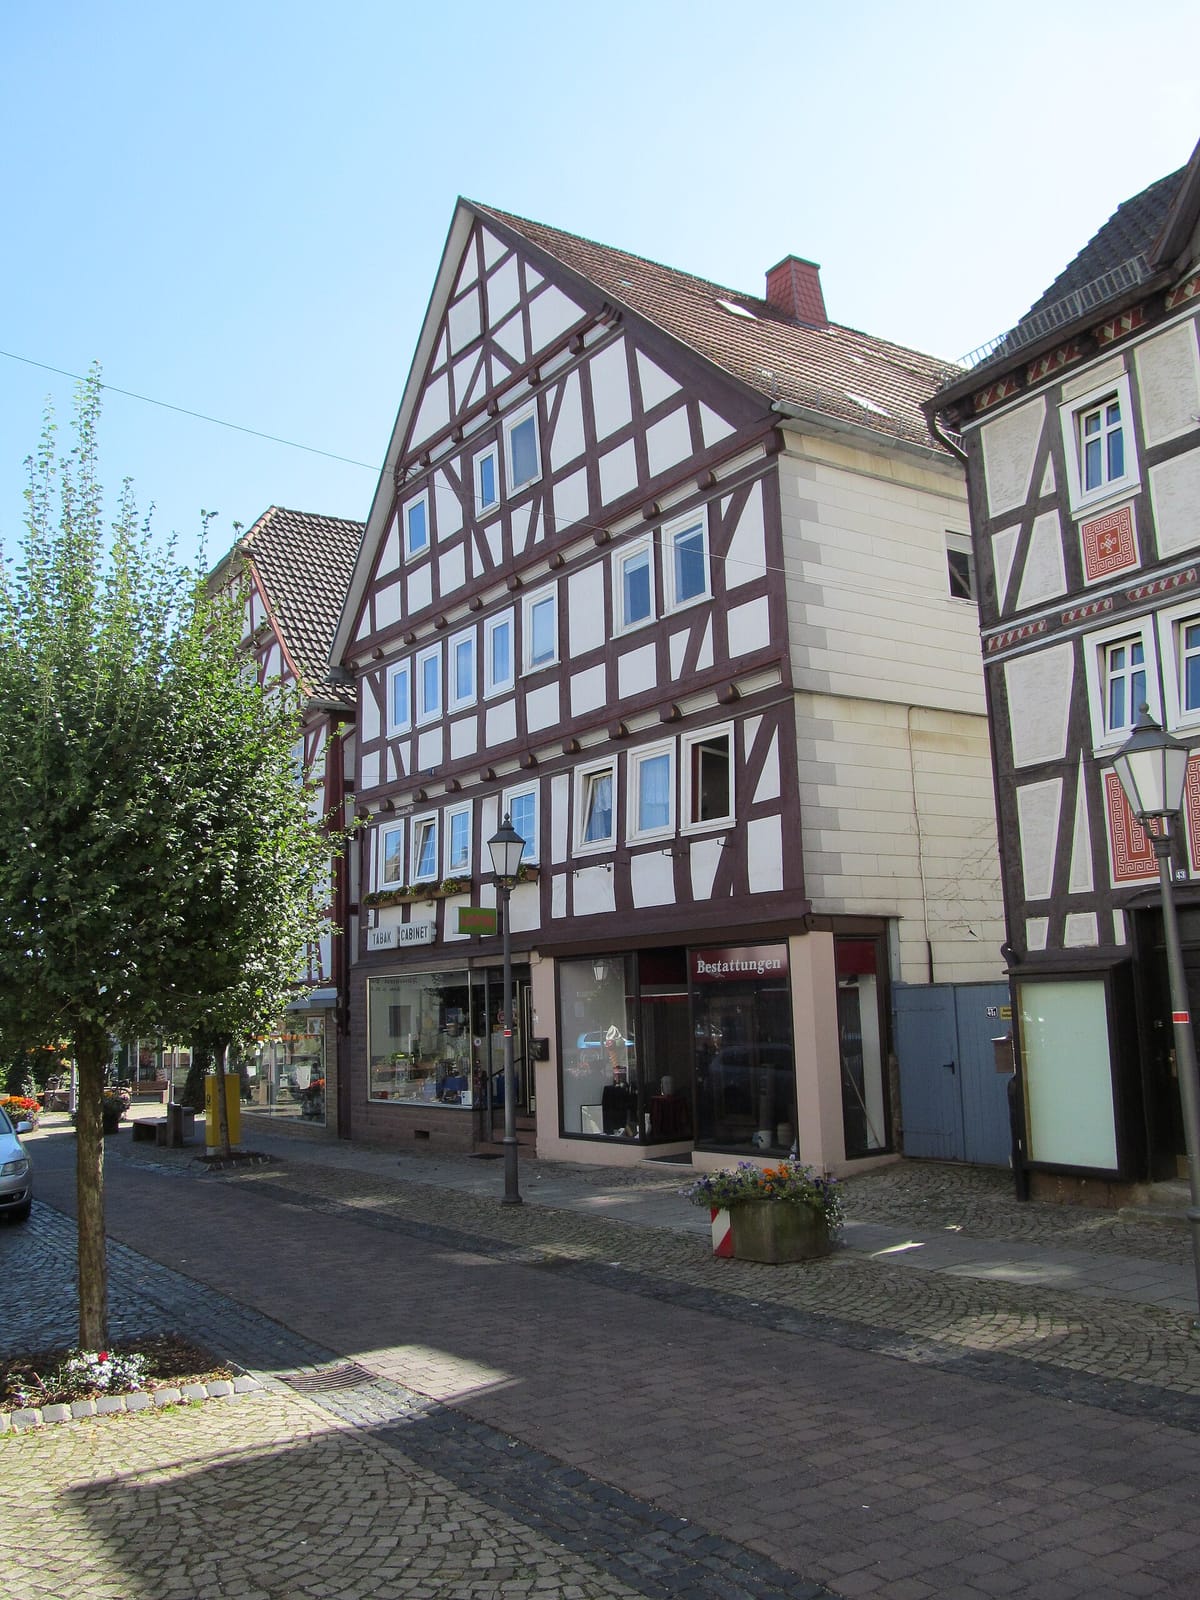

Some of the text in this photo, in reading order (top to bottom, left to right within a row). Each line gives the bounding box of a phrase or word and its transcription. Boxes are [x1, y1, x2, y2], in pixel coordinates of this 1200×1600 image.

[1176, 871, 1185, 880] 43
[373, 926, 428, 945] TABAK CABINET
[697, 959, 781, 975] Bestattungen
